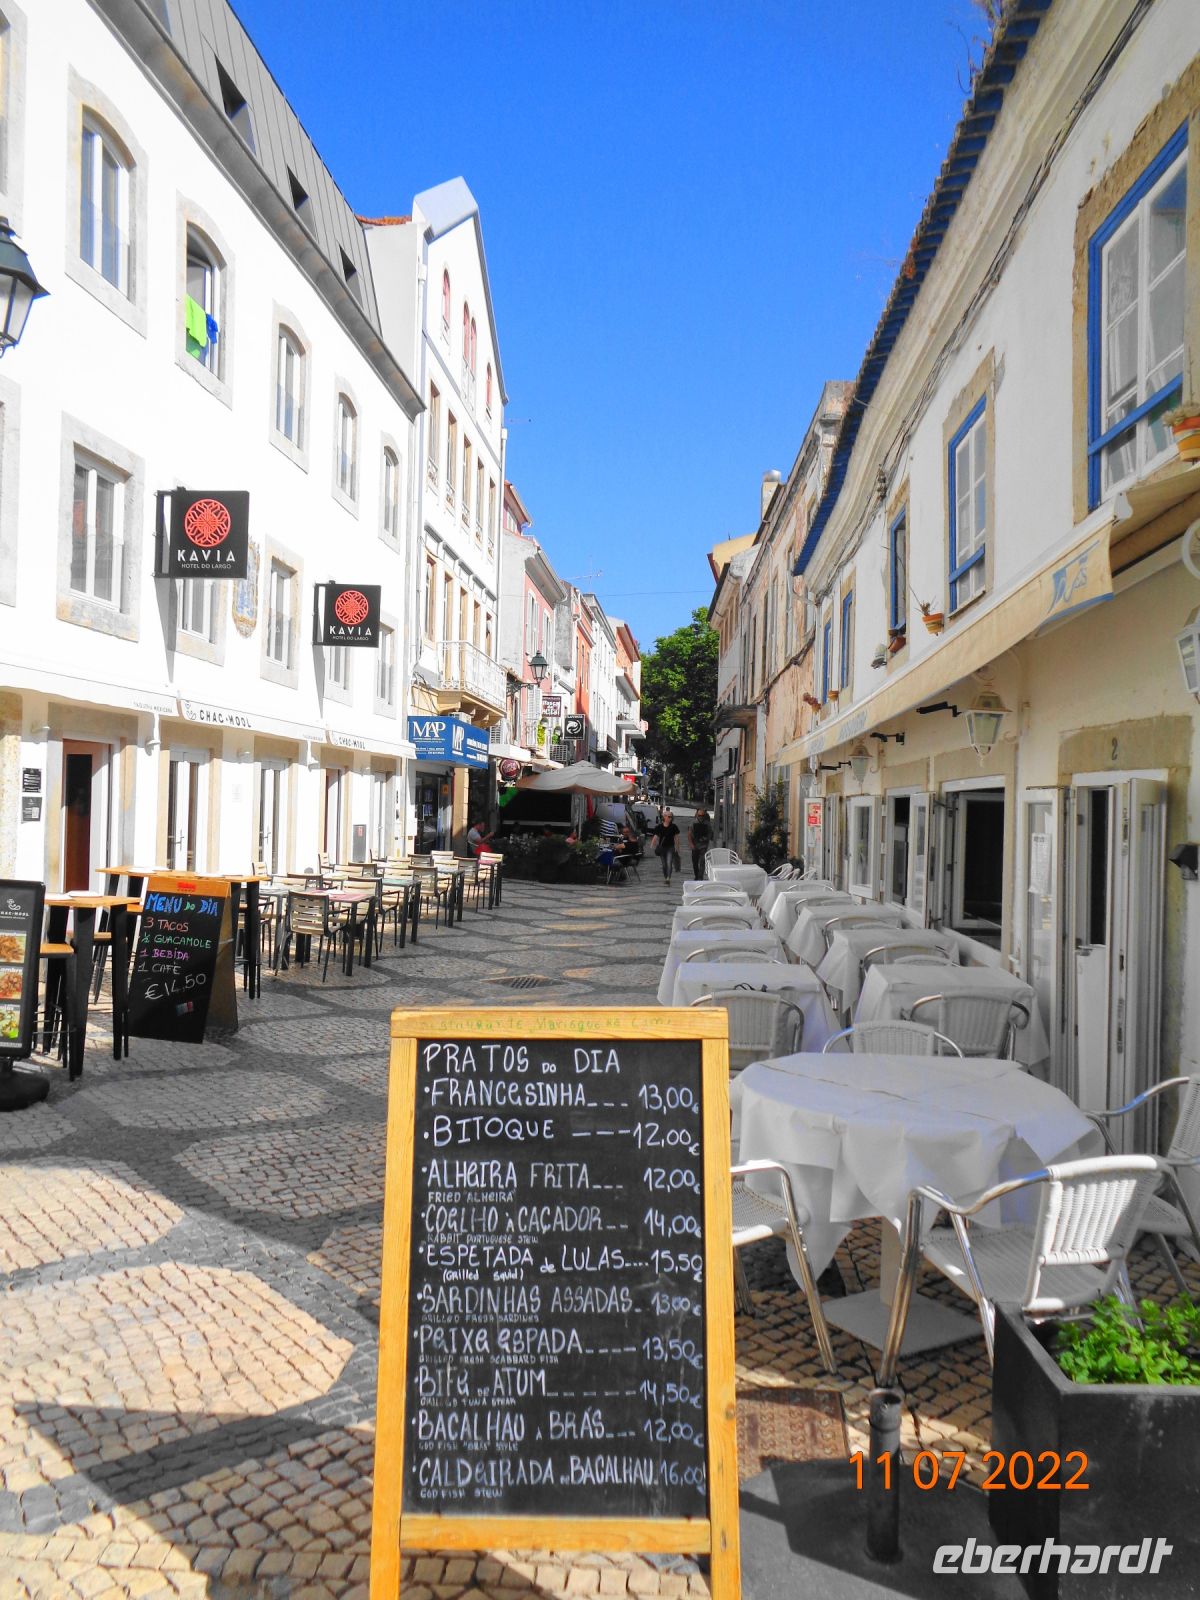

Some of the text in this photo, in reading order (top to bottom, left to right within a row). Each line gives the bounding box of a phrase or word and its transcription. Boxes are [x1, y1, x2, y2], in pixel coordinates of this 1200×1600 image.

[178, 549, 236, 562] KAVIA
[329, 625, 372, 636] KAVIA
[413, 721, 446, 738] MAP
[1110, 737, 1119, 761] 2
[145, 893, 182, 914] MENU
[144, 916, 189, 932] 3 TACOS
[154, 934, 212, 949] GUACAMOLE
[137, 961, 148, 973] 1
[423, 1042, 529, 1074] PRATOS
[573, 1048, 621, 1074] DIA
[433, 1114, 554, 1147] BITOQUE
[530, 1162, 589, 1189] FRITA
[517, 1205, 603, 1235] CAÇADOR
[426, 1244, 534, 1268] ESPETADA
[561, 1244, 626, 1272] LULAS
[422, 1283, 541, 1314] SARDINHAS
[550, 1284, 633, 1313] ASSADAS
[493, 1366, 546, 1397] ATUM
[418, 1408, 525, 1441] BACALHAU
[549, 1405, 605, 1441] BRÁS
[570, 1454, 654, 1488] BACALHAU
